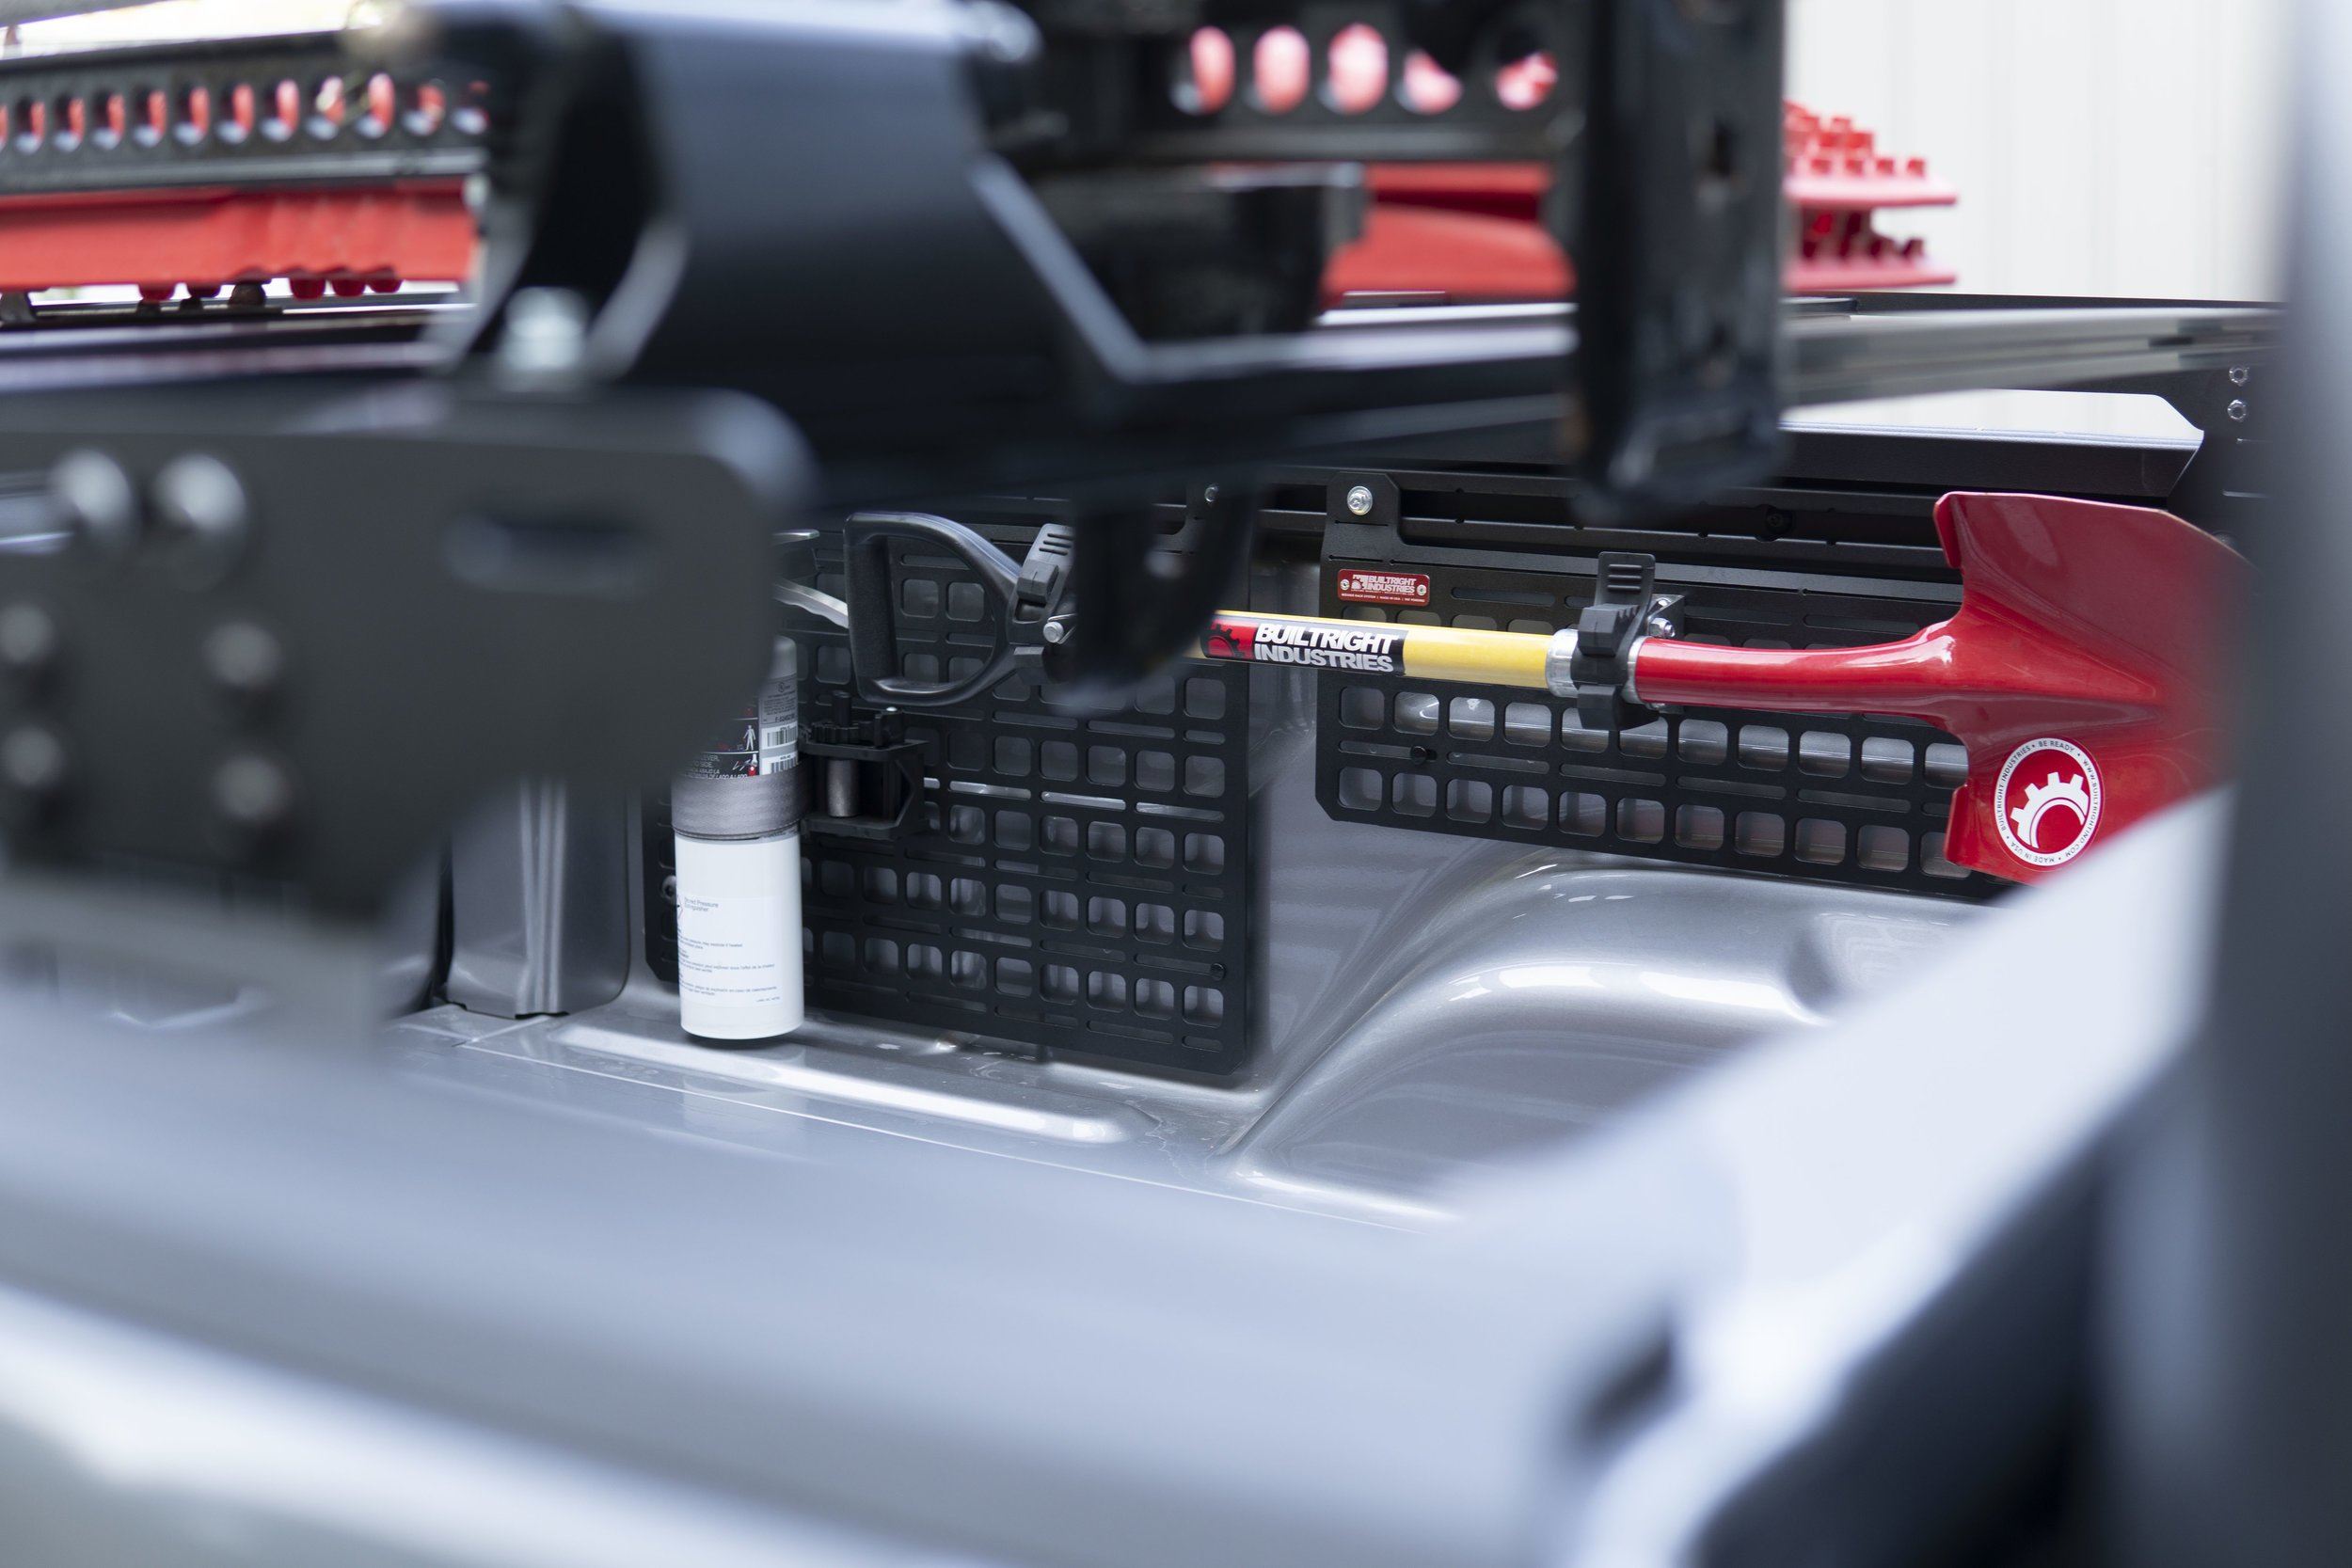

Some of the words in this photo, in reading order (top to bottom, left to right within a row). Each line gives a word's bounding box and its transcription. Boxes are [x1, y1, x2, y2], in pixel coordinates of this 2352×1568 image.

[1369, 576, 1417, 586] BUILTRIGHT
[1368, 583, 1415, 594] INDUSTRIES
[1254, 623, 1400, 654] BUILTRIGHT
[1254, 643, 1394, 673] INDUSTRIES
[2050, 740, 2074, 752] READY
[1995, 784, 2007, 832] BUILTRIGHT
[2002, 745, 2031, 783] INDUSTRIES
[2010, 841, 2023, 853] USA
[2034, 855, 2055, 863] MADE
